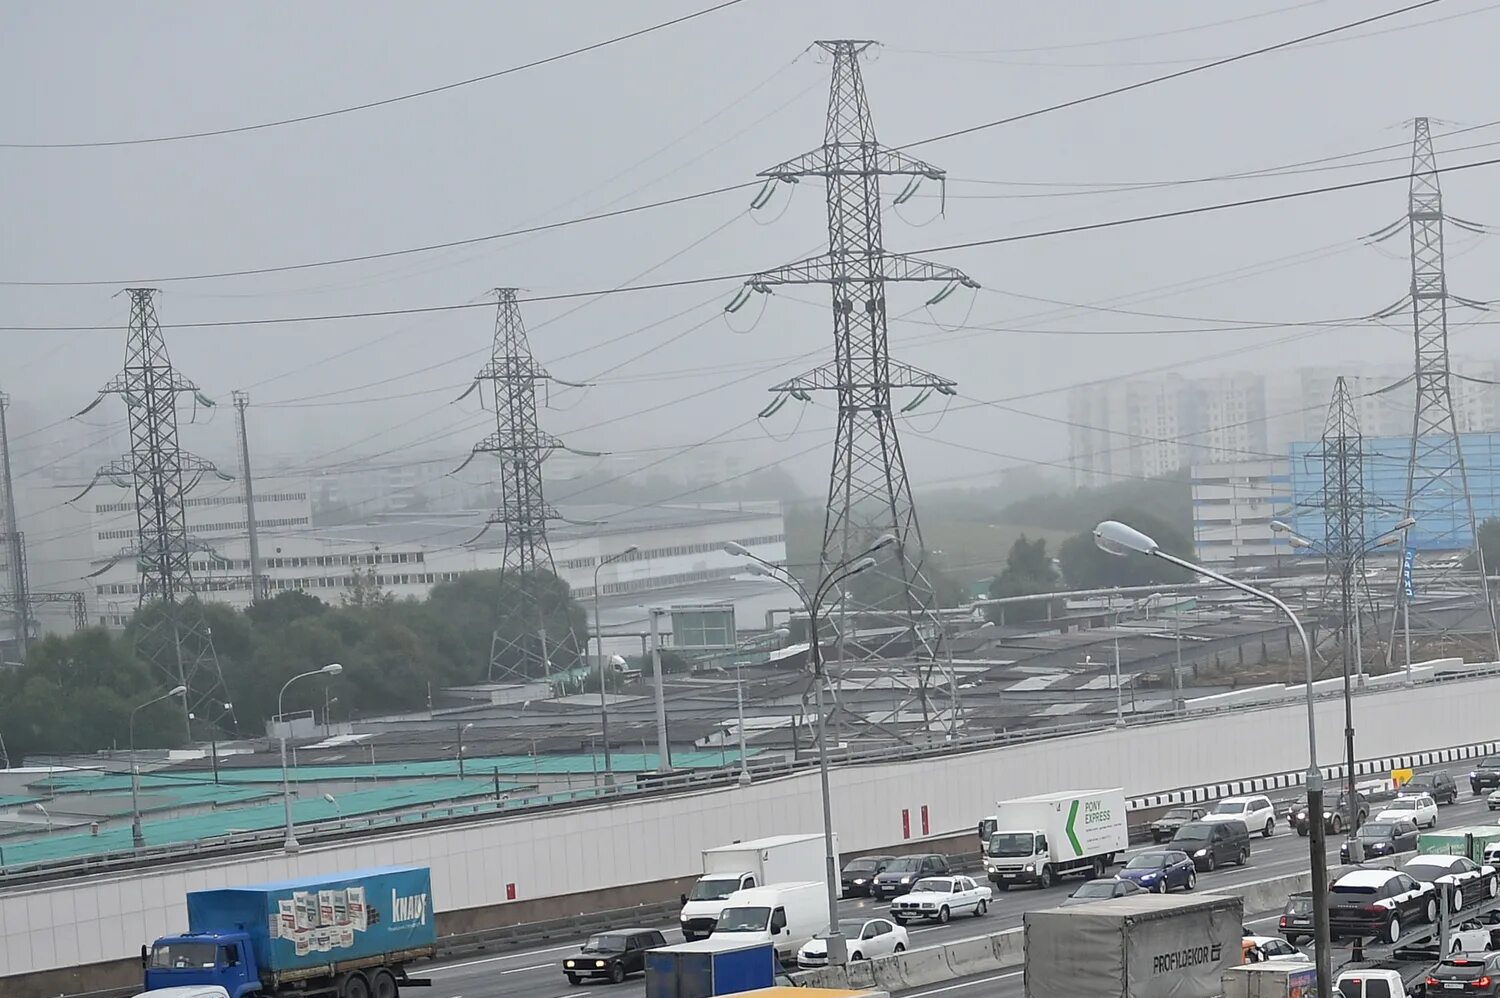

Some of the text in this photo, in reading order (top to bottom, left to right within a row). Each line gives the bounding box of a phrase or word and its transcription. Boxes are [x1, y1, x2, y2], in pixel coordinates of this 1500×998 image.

[1085, 800, 1101, 812] PONY
[1085, 810, 1110, 824] EXPRESS
[392, 888, 427, 925] KNAUF
[1153, 946, 1208, 974] PROFILDEKOR
